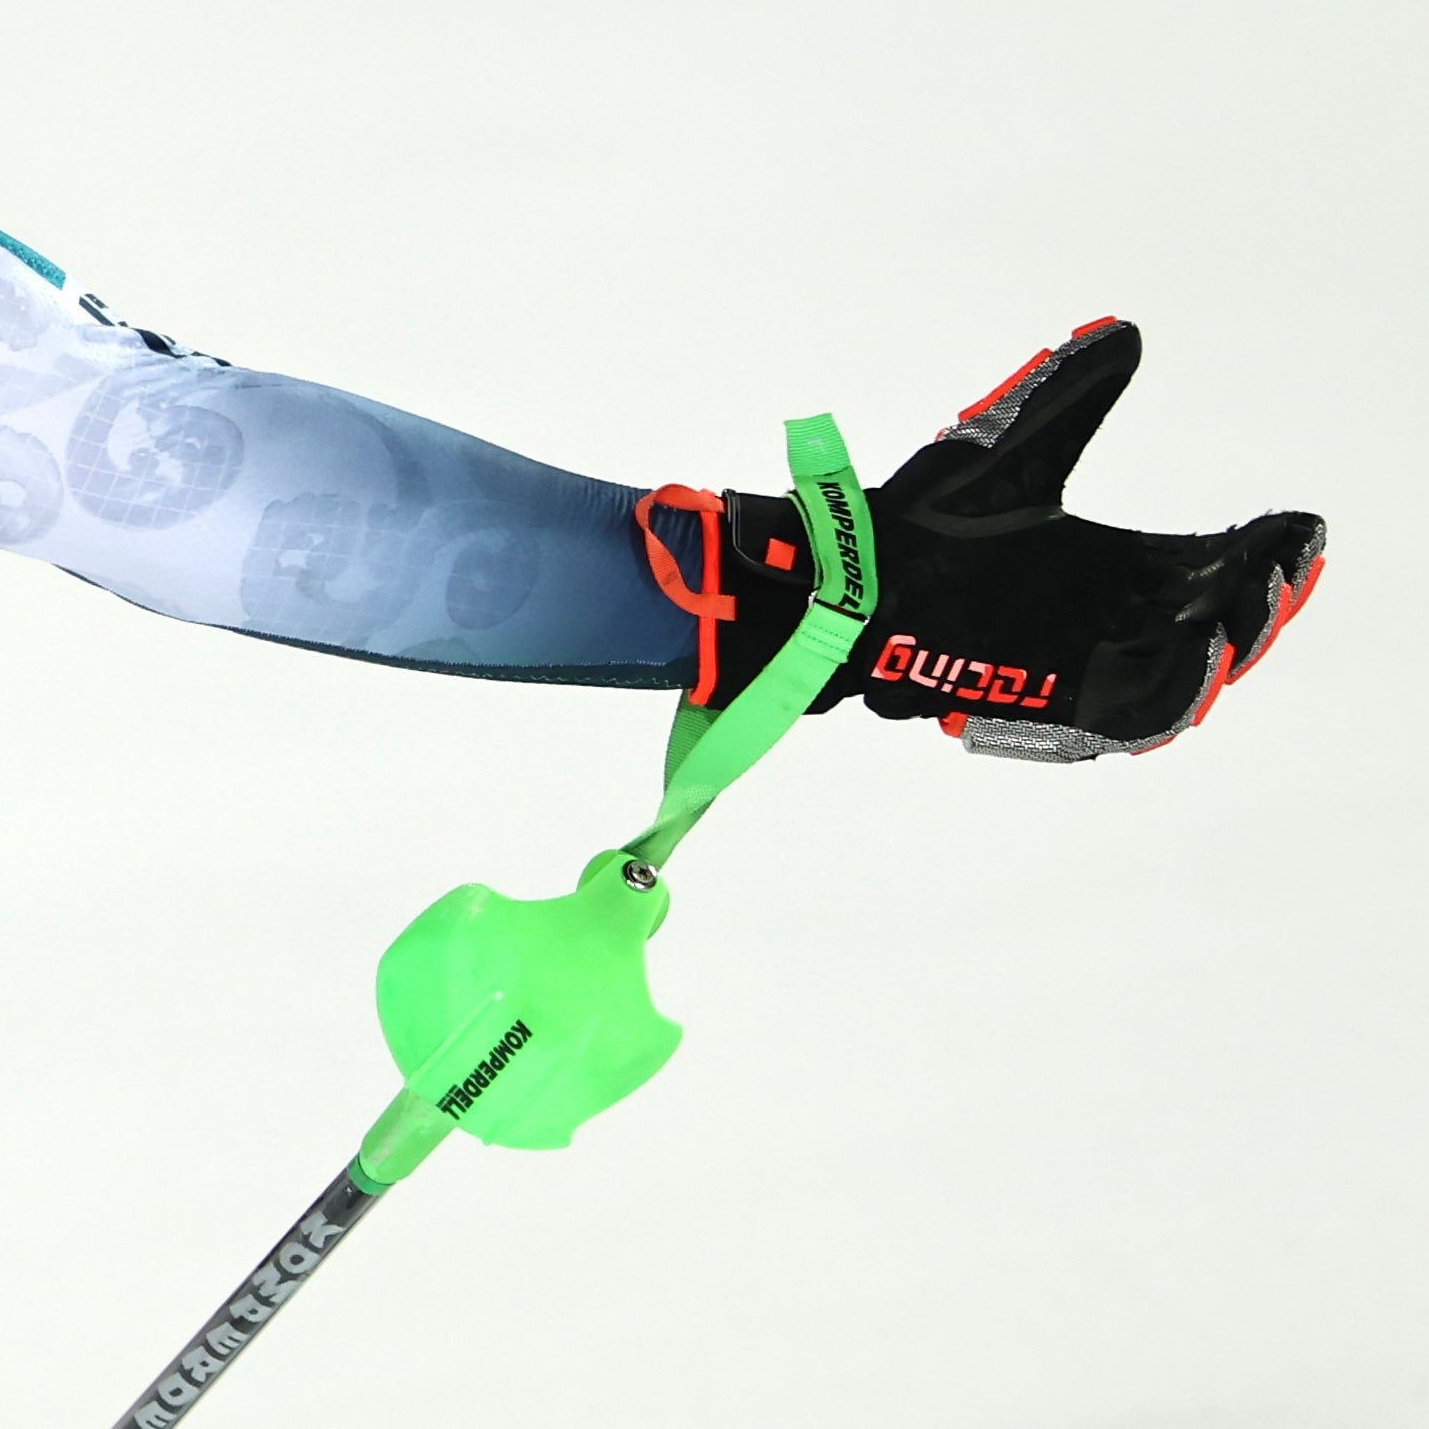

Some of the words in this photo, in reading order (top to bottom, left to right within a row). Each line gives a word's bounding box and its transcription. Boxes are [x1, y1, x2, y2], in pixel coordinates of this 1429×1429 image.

[816, 481, 865, 611] KOMPERDEL
[870, 634, 1058, 709] racing
[440, 1019, 533, 1121] KOMPERDELL
[133, 1210, 346, 1429] KOMPERDE
